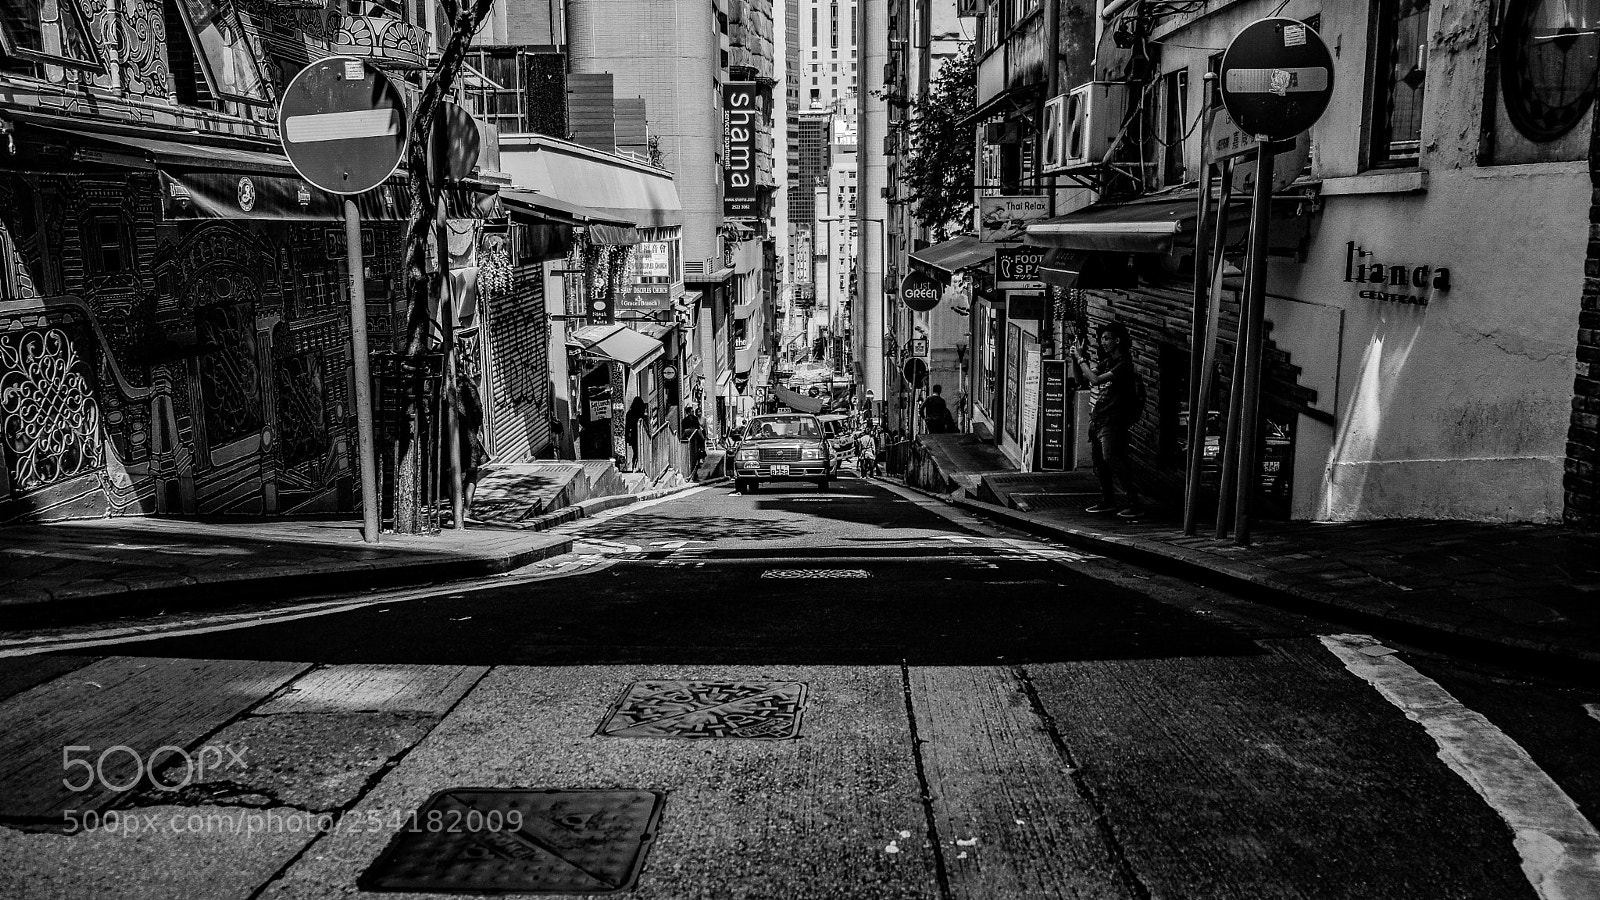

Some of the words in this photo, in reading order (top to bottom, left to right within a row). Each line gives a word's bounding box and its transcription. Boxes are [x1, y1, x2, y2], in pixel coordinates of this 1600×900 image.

[731, 93, 756, 188] shama
[1006, 202, 1023, 211] Thai
[1025, 202, 1046, 211] Relax
[1015, 254, 1045, 264] FOOT
[1359, 290, 1428, 306] CENTRAL
